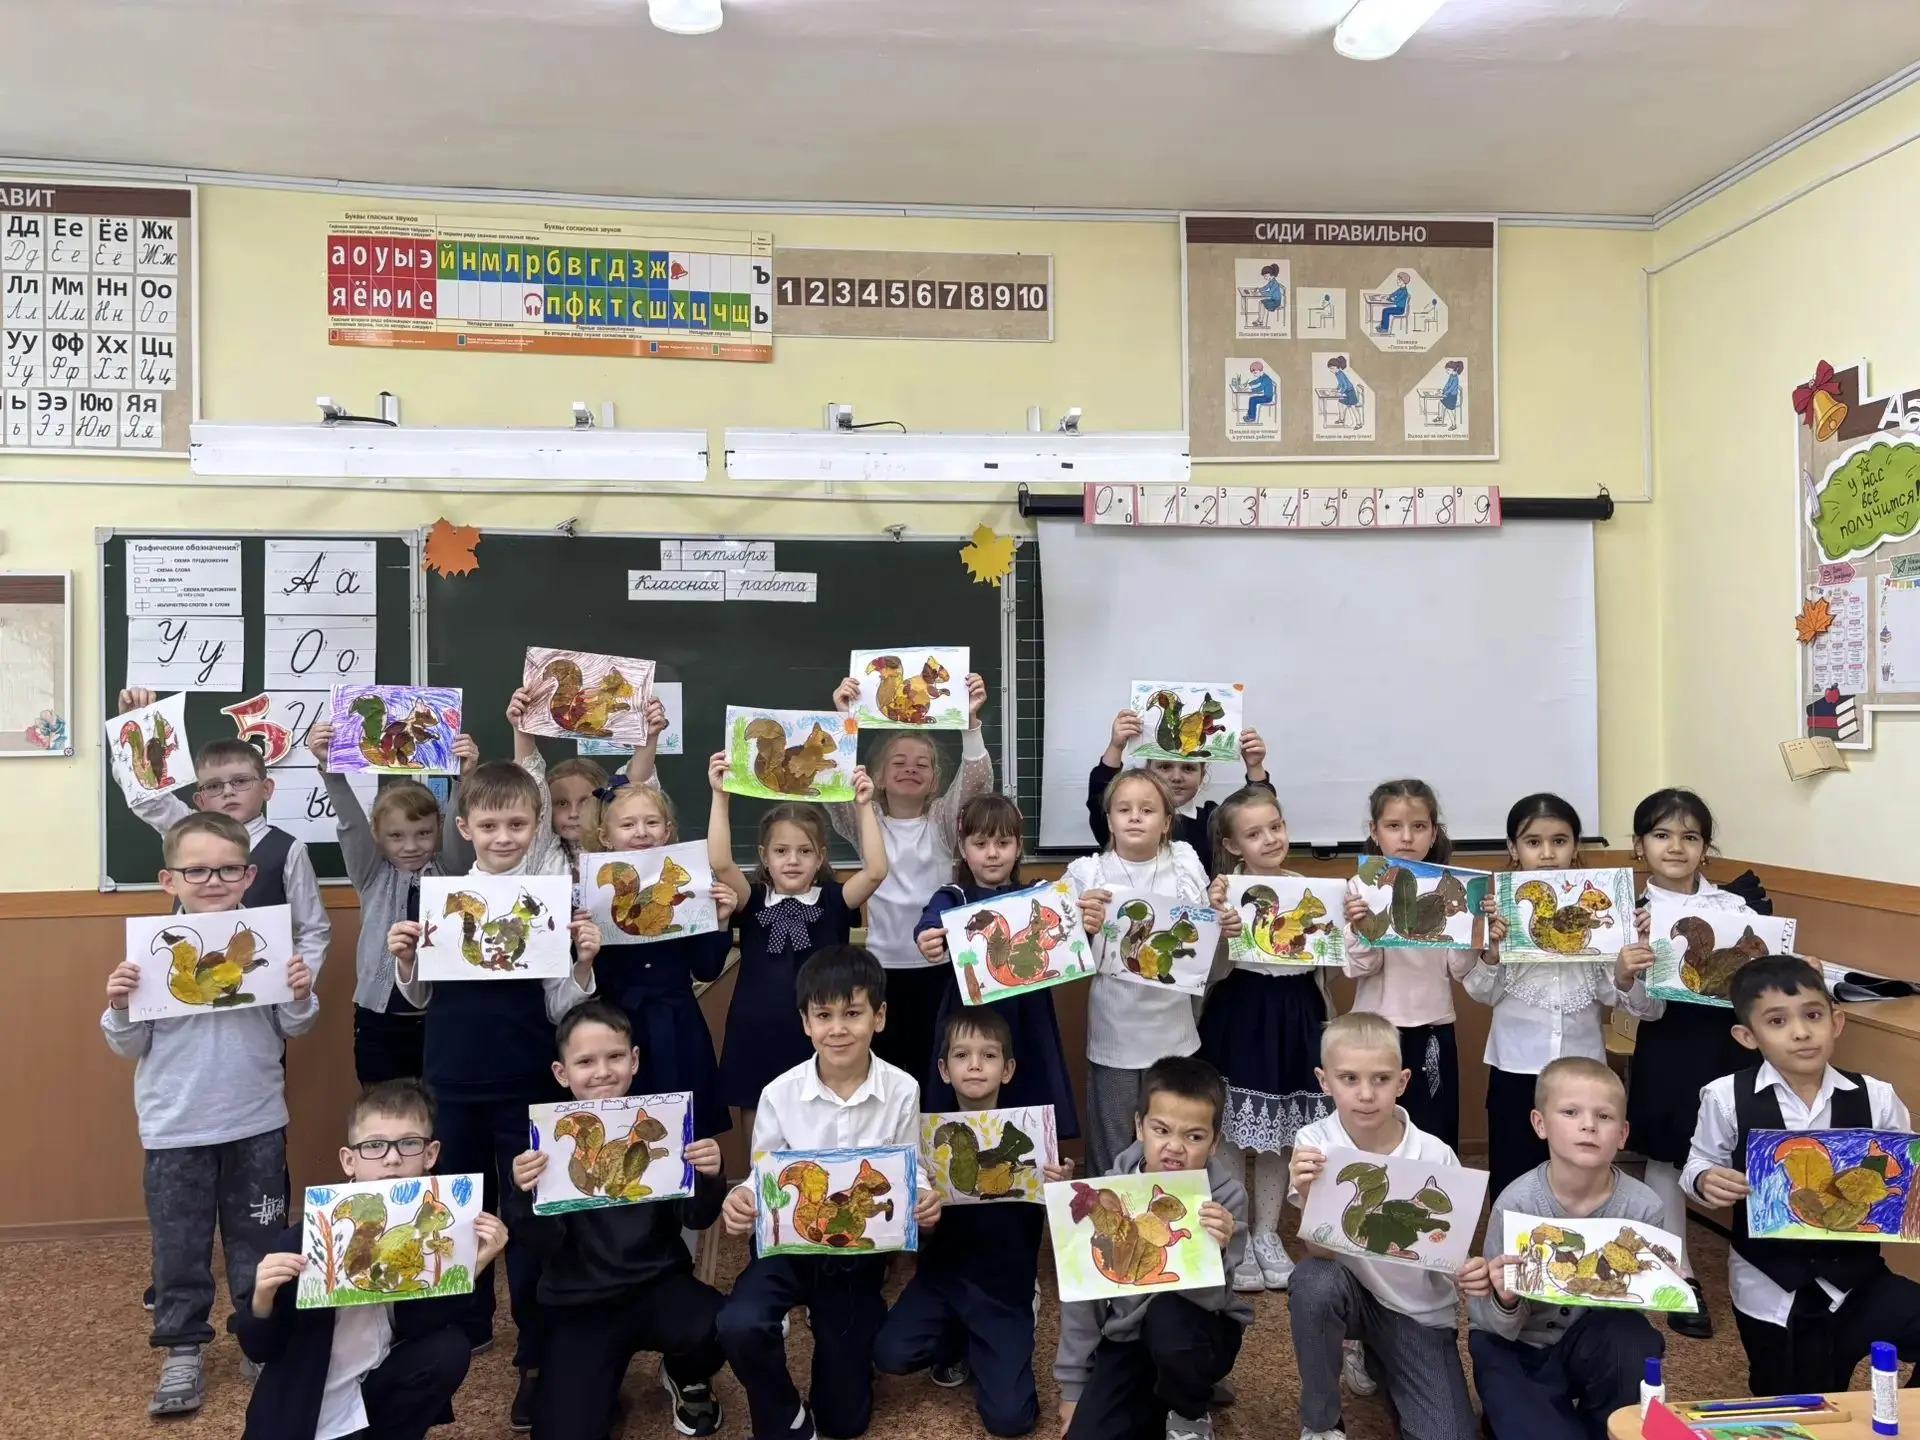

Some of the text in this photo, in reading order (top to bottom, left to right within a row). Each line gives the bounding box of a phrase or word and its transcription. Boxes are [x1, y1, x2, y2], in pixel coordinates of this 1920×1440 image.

[7, 216, 173, 242] Дд Ее Ёё Жж
[1255, 223, 1427, 243] СИДИ ПРАВИЛЬНО
[7, 276, 172, 299] Лл Мм Нн Оо
[781, 280, 1044, 309] 1 2 3 4 5 6 7 8 9 10
[7, 331, 173, 357] Уу Фф Хх Цц
[38, 392, 157, 413] Ээ Юю Яя
[1862, 467, 1885, 491] нас
[1140, 487, 1463, 499] 1 2 3 4 5 6 7 8 9
[1862, 487, 1880, 509] всё
[1095, 486, 1490, 527] 0 1 2 3 4 5 6 7 8 9
[1125, 513, 1132, 523] 0
[1840, 479, 1920, 540] получится!
[135, 544, 184, 552] Графические
[693, 542, 768, 568] октября
[284, 552, 360, 594] А а
[634, 573, 808, 598] Классная работа
[291, 629, 324, 674] О
